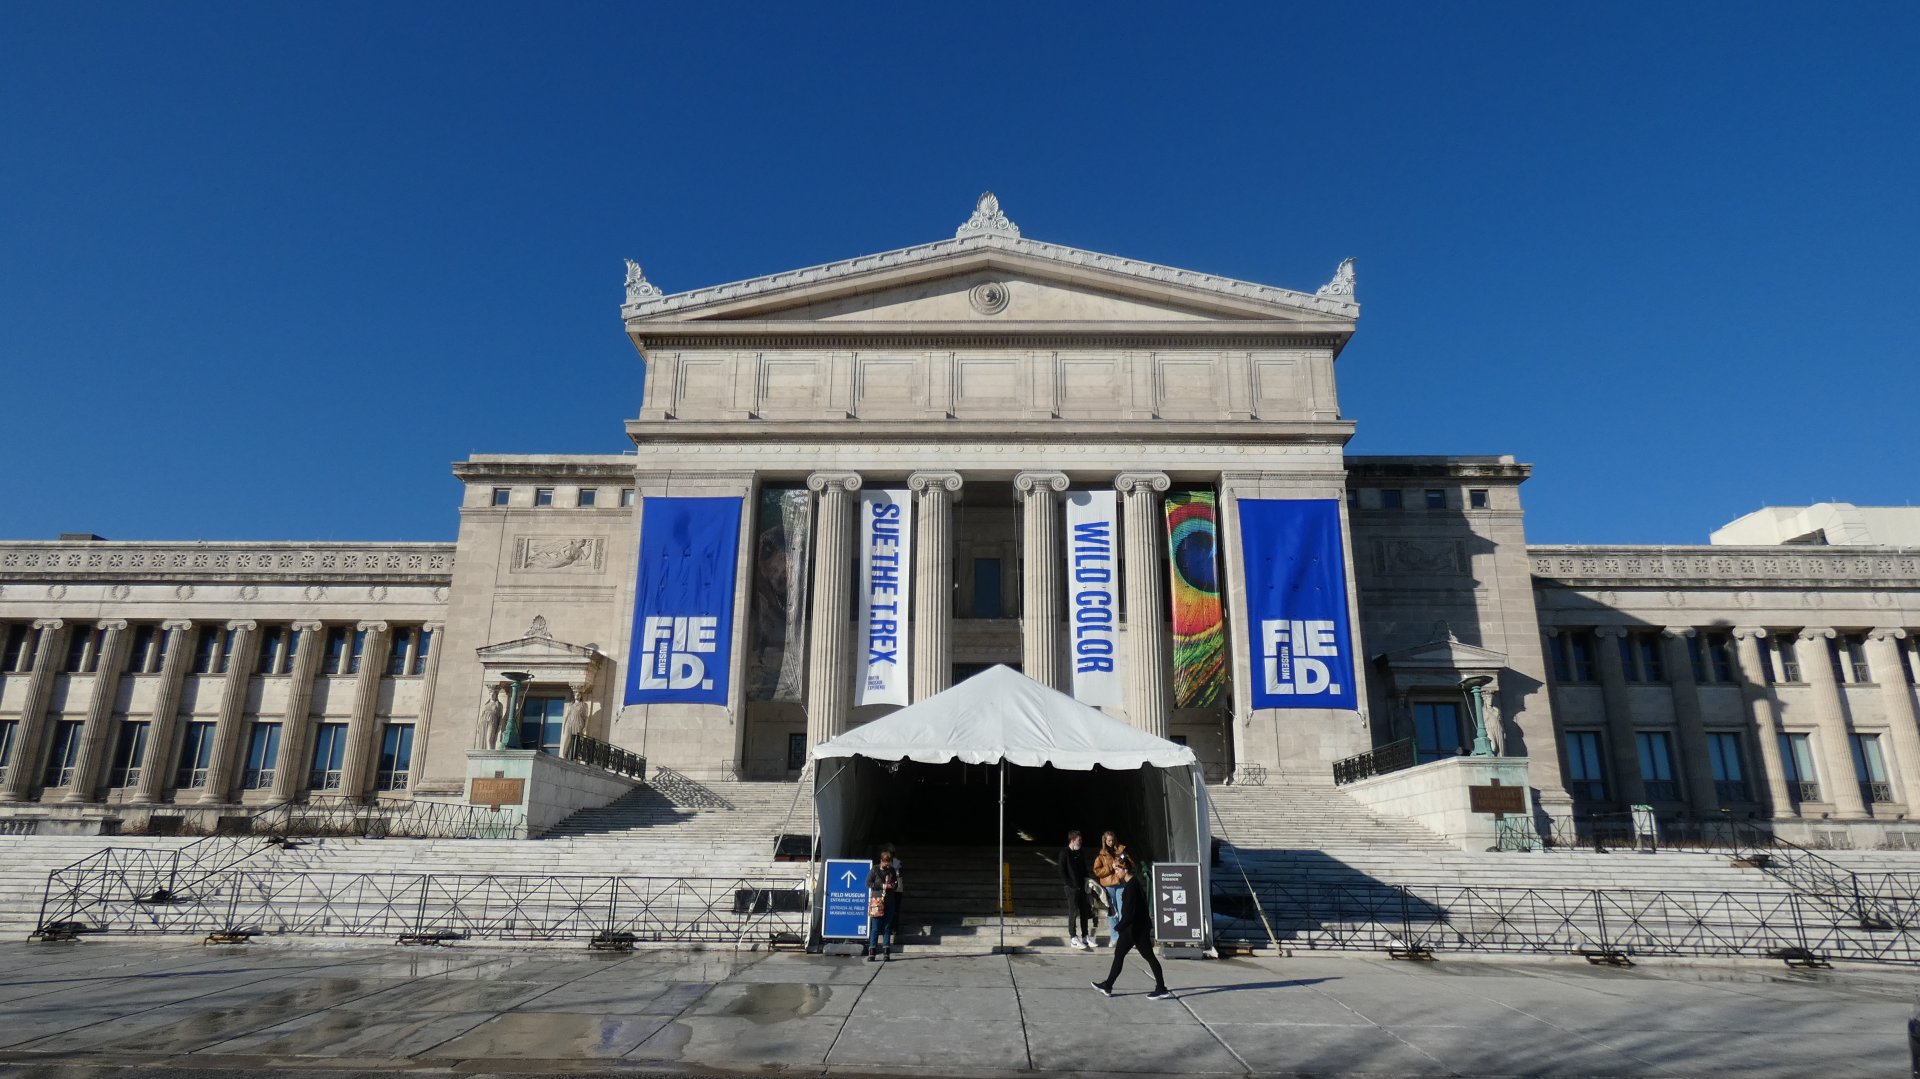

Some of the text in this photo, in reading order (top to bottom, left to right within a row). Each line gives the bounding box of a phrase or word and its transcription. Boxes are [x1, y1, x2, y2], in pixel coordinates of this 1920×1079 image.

[868, 503, 900, 665] SUE THE T.REX
[1074, 521, 1113, 673] WILD COLOR
[657, 642, 668, 675] MUSEUM
[1280, 646, 1291, 680] MUSEUM
